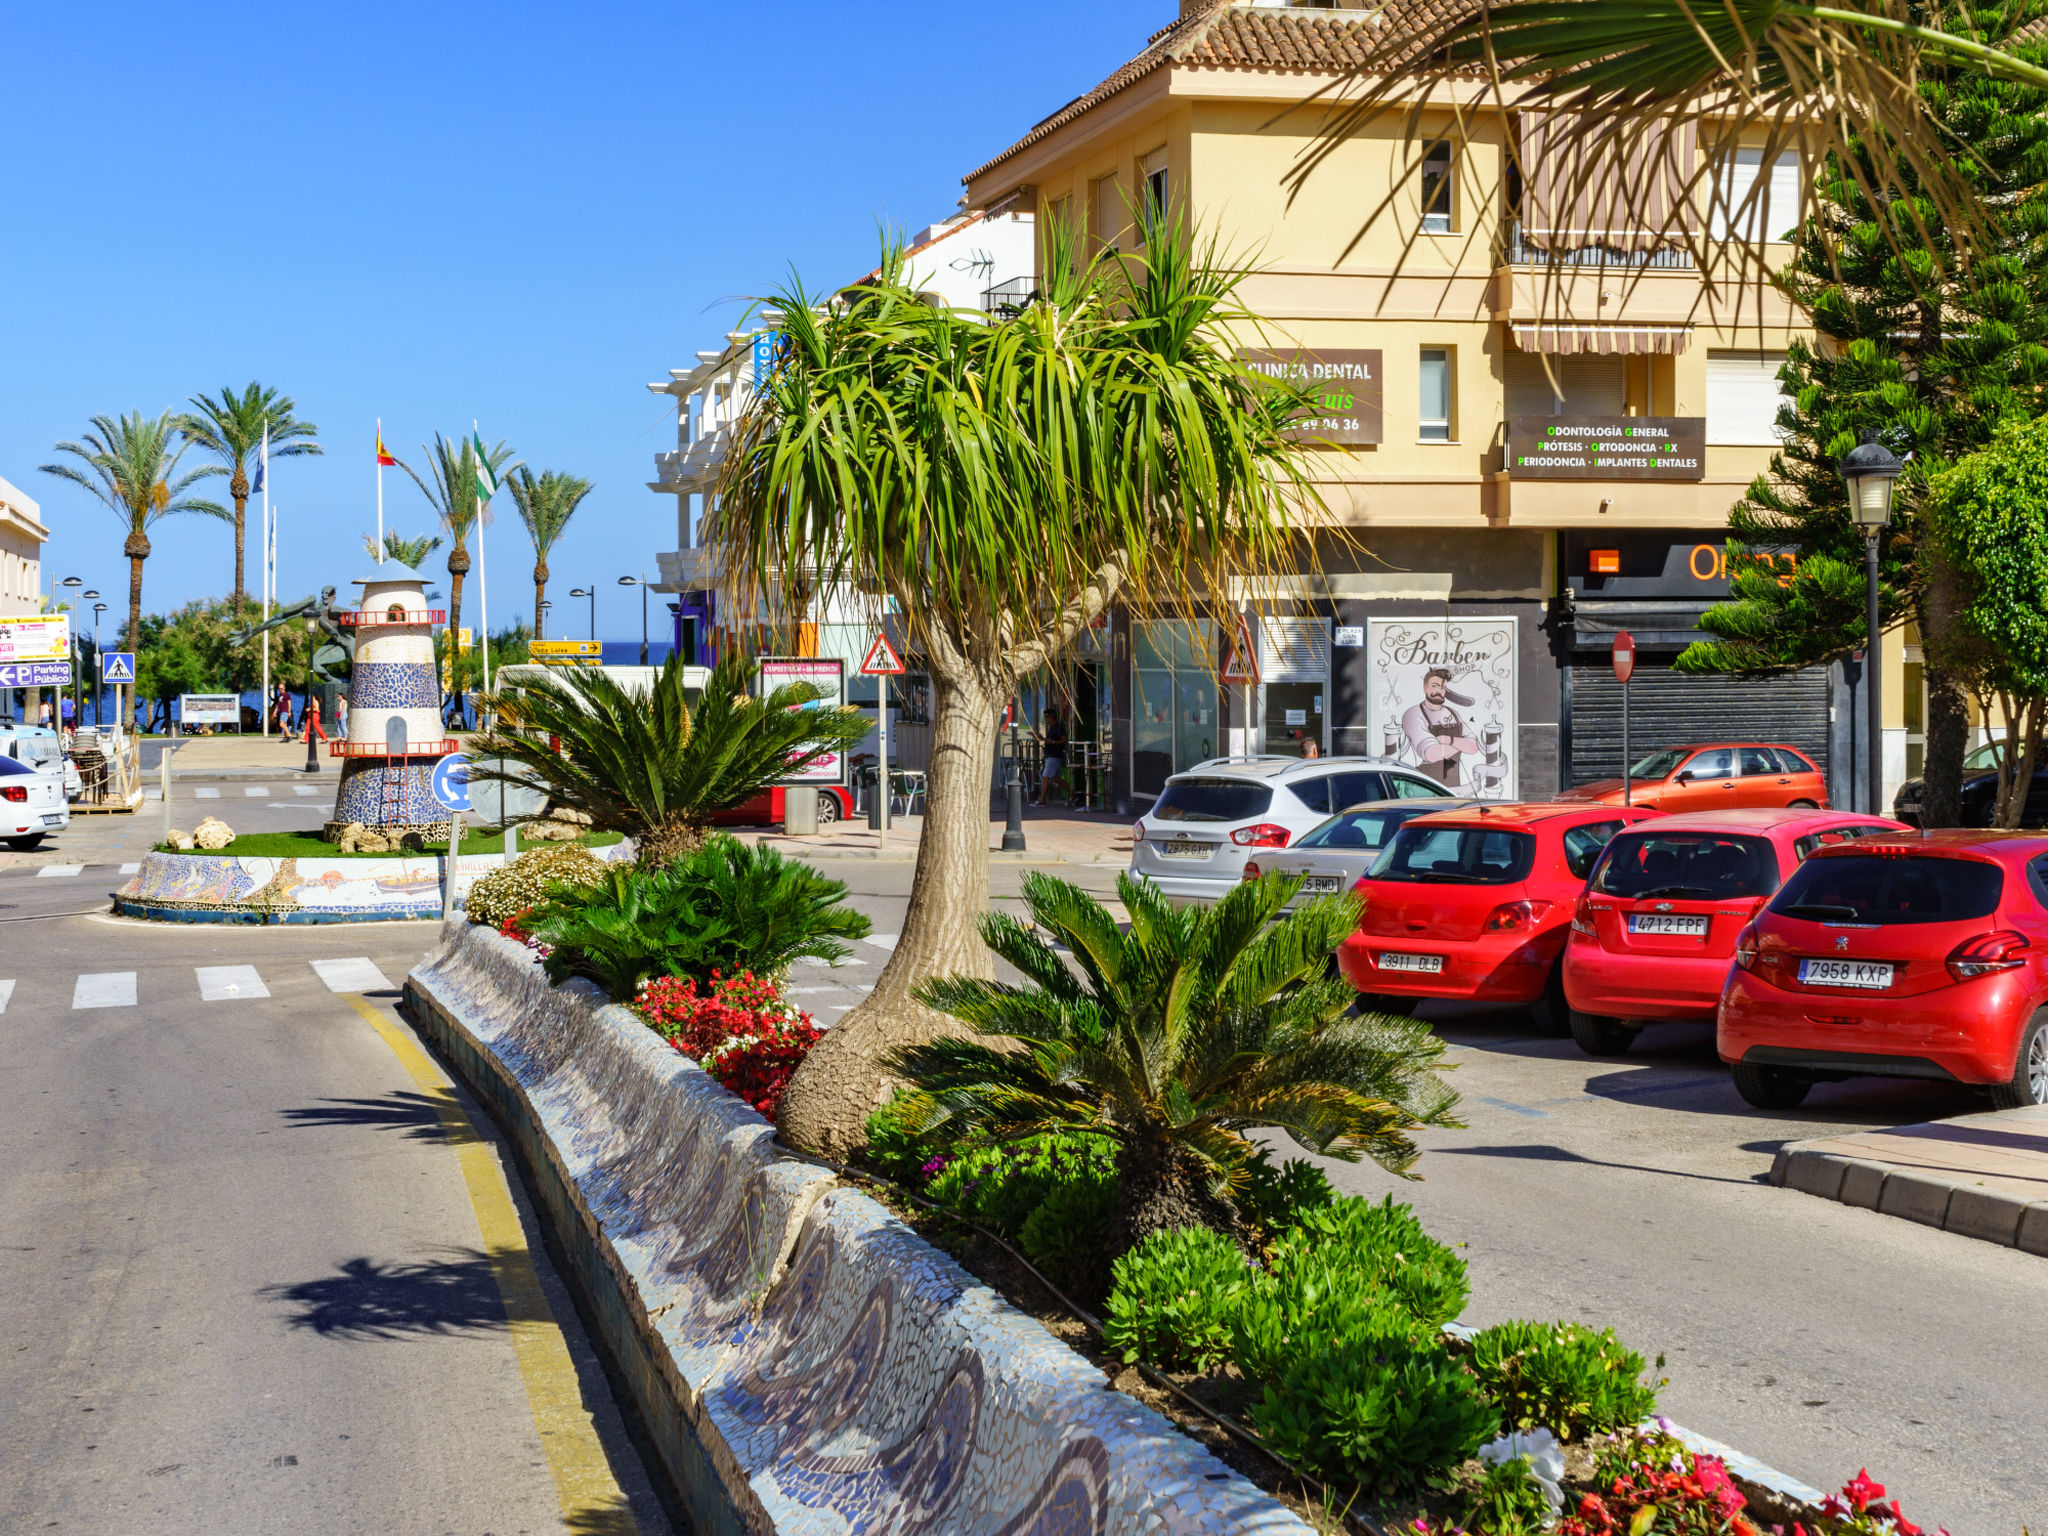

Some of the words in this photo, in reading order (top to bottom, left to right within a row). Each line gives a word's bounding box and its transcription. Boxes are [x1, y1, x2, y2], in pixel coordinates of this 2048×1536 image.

[1313, 363, 1371, 379] DENTAL
[1343, 418, 1359, 431] 36
[1547, 424, 1622, 437] ODONTOLOGÍA
[1625, 427, 1669, 437] GENERAL
[1537, 440, 1582, 452] PRÓTESIS
[1591, 442, 1656, 452] ORTODONCIA
[1664, 443, 1678, 453] RX
[1518, 457, 1585, 467] PERIODONCIA
[1594, 457, 1647, 468] IMPLANTES
[1650, 458, 1697, 468] DENTALES
[33, 665, 69, 675] Parking
[34, 674, 69, 684] Público
[1168, 843, 1191, 854] 2875
[1315, 878, 1334, 891] BMD
[1638, 917, 1672, 932] 4712
[1676, 918, 1704, 933] FPF
[1385, 955, 1410, 968] 3911
[1810, 962, 1850, 980] 7958
[1855, 964, 1889, 983] KXP
